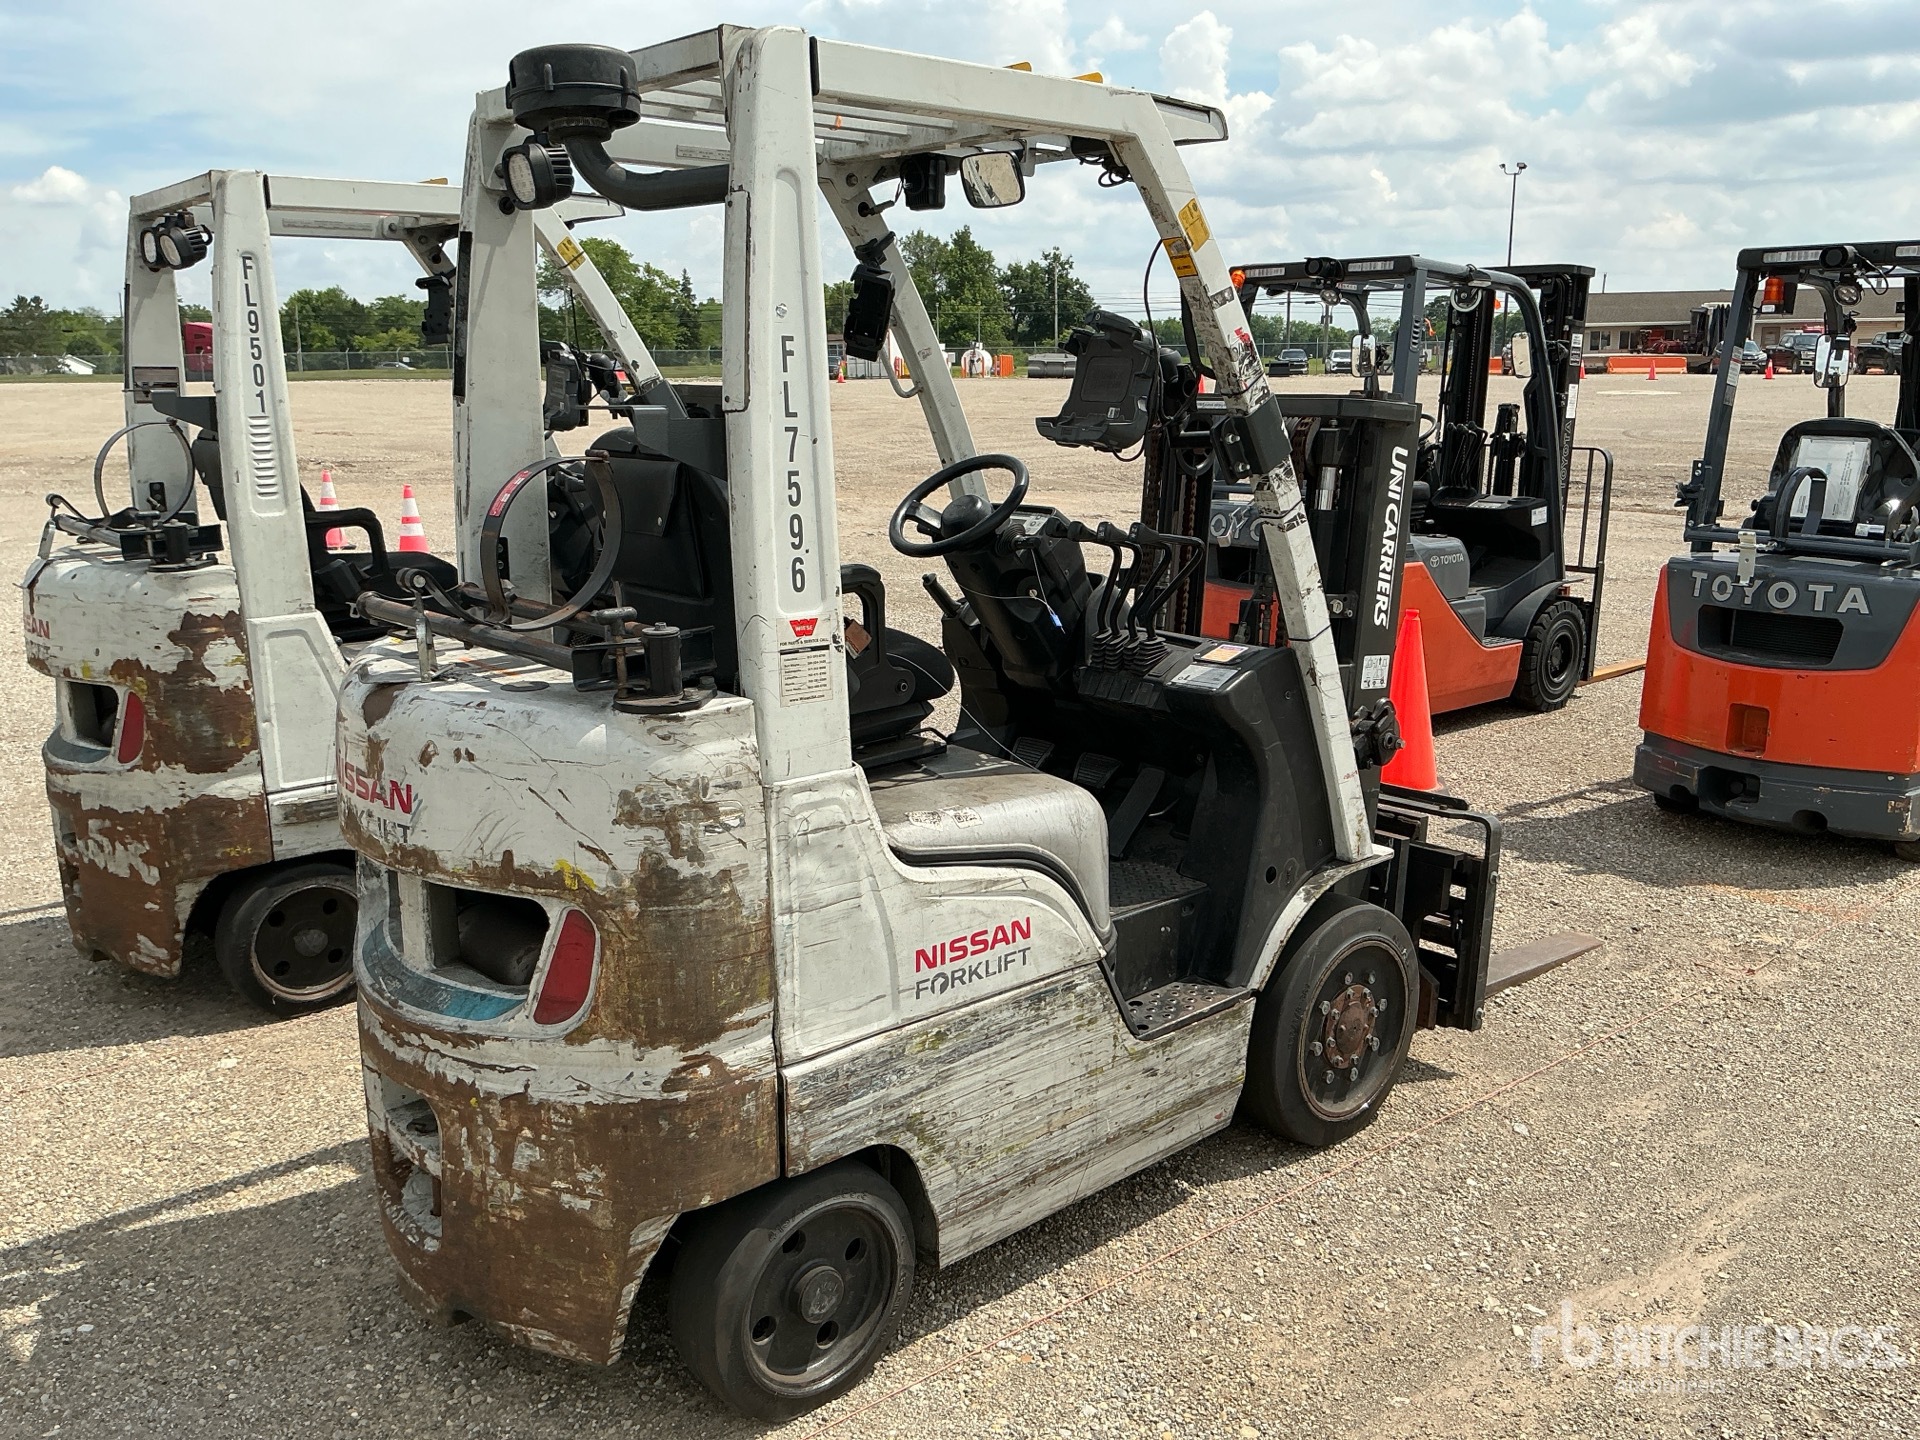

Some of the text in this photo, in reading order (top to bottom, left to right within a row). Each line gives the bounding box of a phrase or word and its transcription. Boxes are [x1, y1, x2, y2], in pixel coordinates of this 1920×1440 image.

[241, 255, 266, 414] FL9501
[780, 335, 806, 592] FL7596
[1440, 553, 1464, 565] TOYOTA
[1690, 571, 1870, 615] TOYOTA
[914, 916, 1032, 973] NISSAN
[914, 946, 1032, 1001] FORKLIFT
